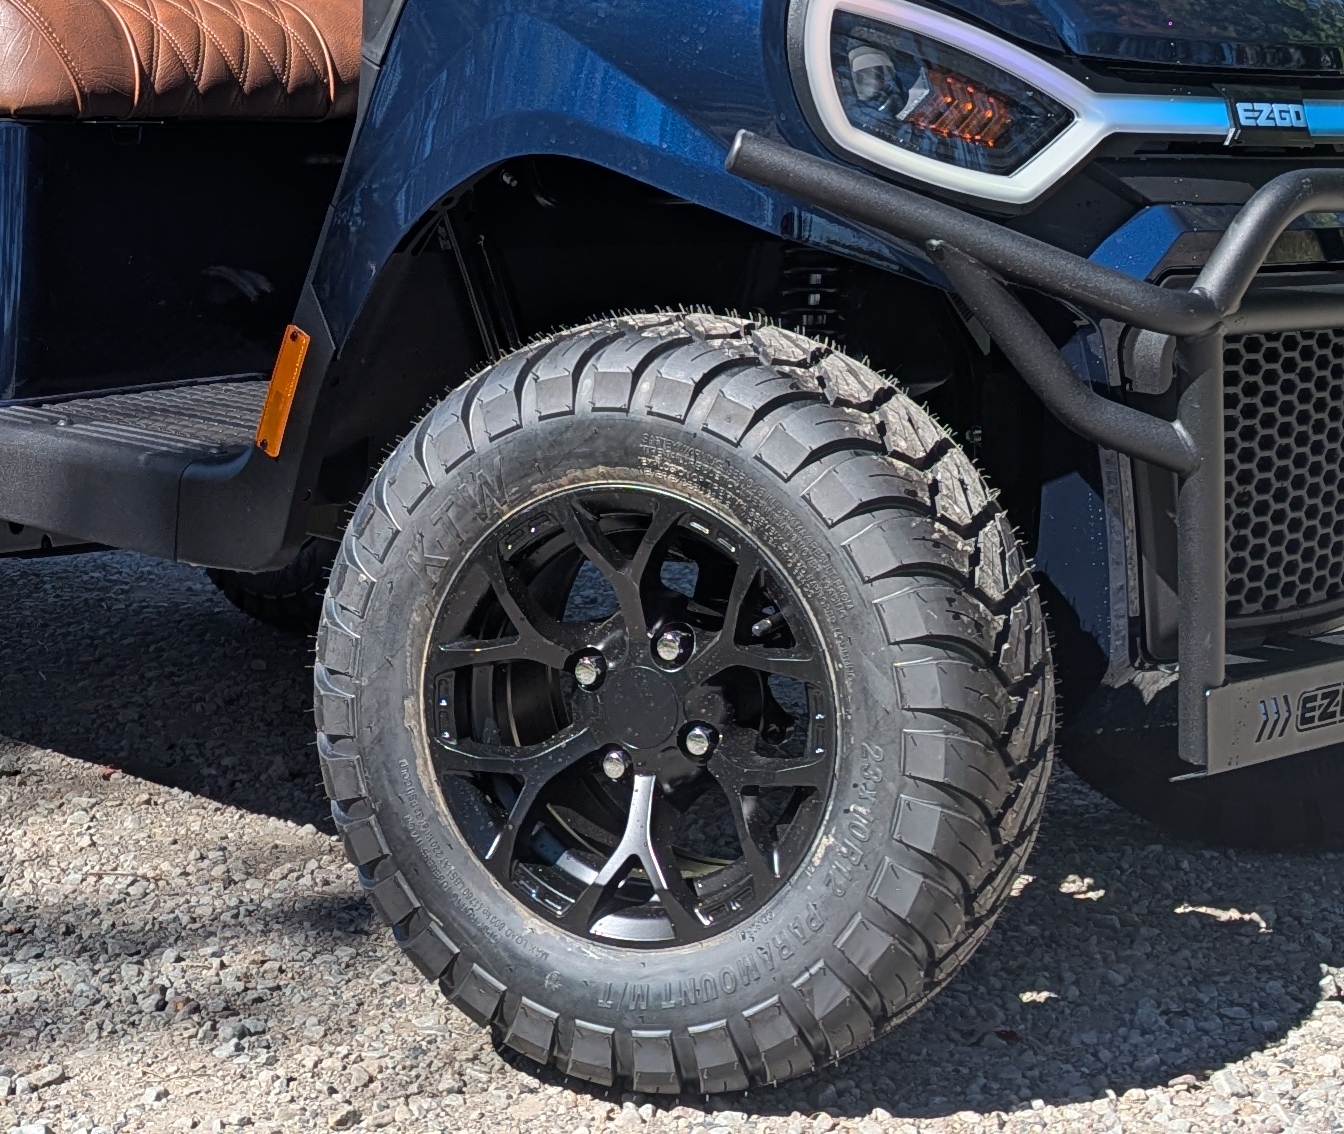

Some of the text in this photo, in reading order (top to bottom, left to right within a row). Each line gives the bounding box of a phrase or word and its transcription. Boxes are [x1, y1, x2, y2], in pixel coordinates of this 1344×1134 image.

[1236, 102, 1308, 128] EZGO
[406, 455, 510, 591] KTW
[503, 925, 529, 950] LOAD
[660, 902, 825, 1009] PARAMOUNT
